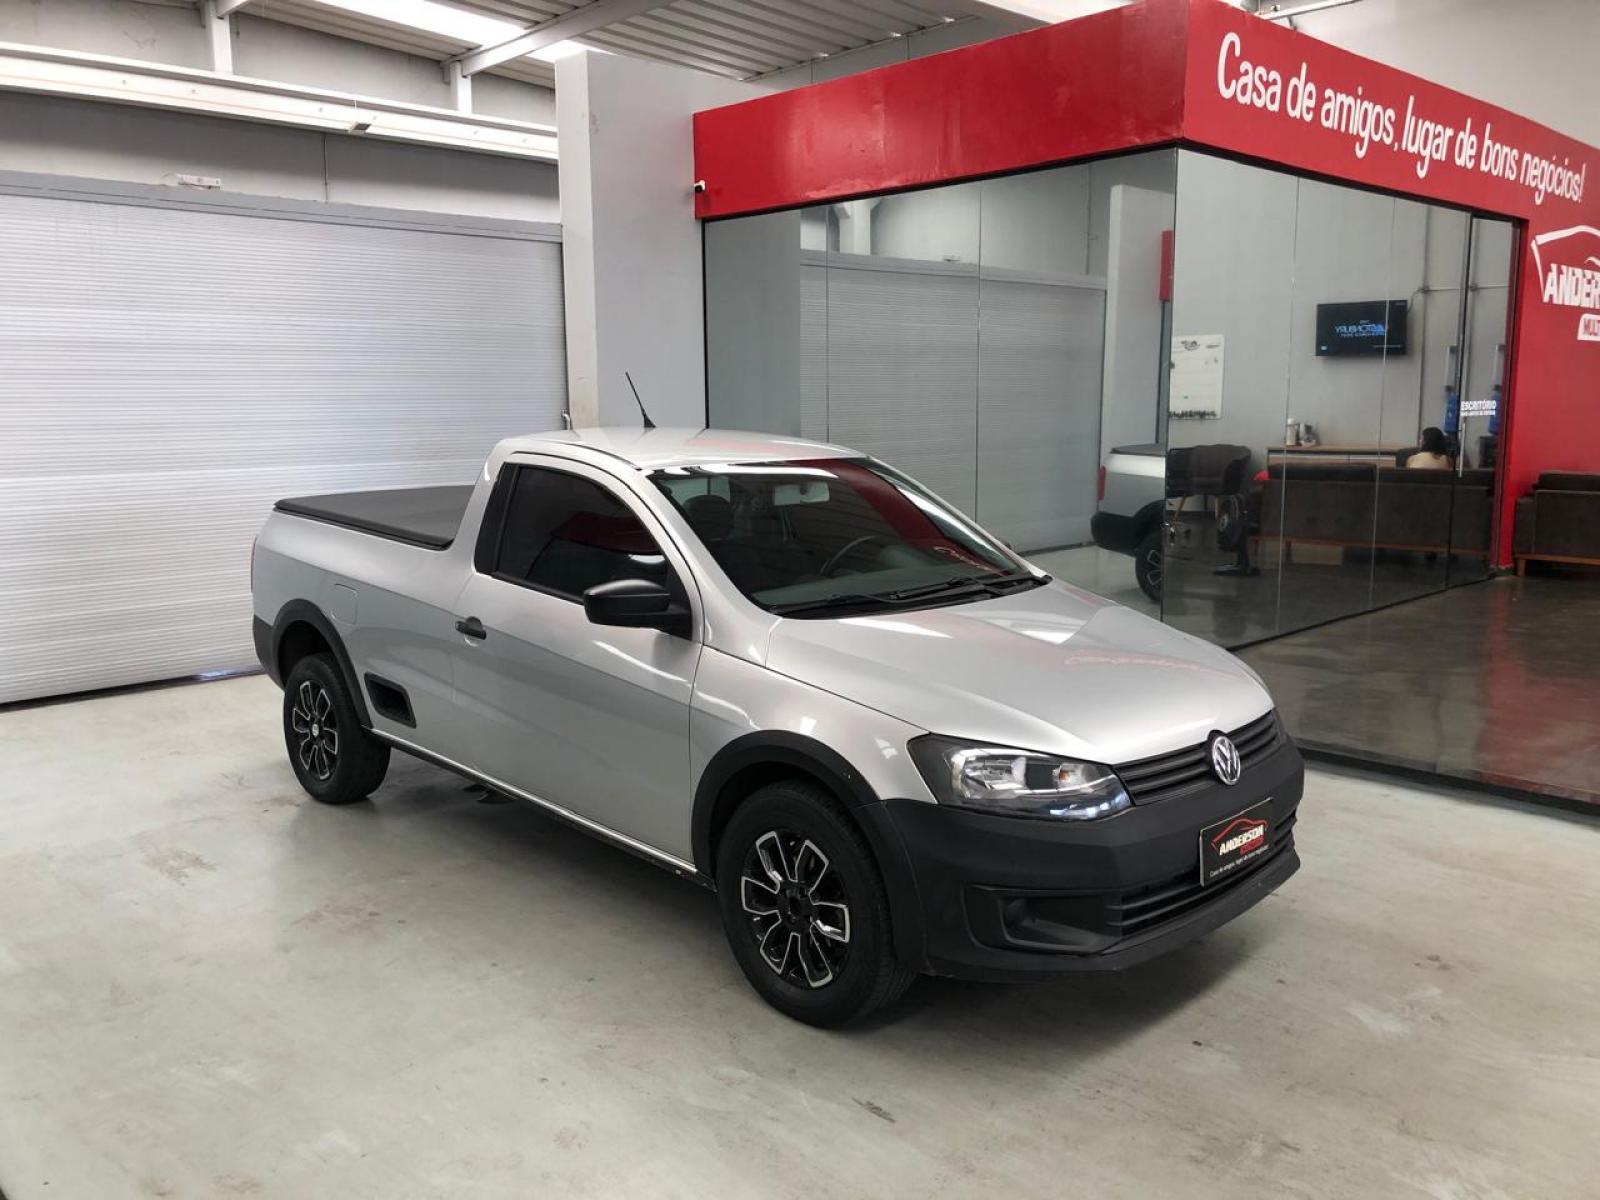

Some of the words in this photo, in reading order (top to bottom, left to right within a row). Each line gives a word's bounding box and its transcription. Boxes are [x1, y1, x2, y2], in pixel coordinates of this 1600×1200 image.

[1217, 32, 1282, 112] Casa
[1286, 62, 1316, 122] de
[1321, 85, 1398, 158] amigos,
[1402, 95, 1454, 179] lugar
[1455, 117, 1477, 170] de
[1480, 122, 1519, 181] bons
[1520, 153, 1586, 205] negócios!
